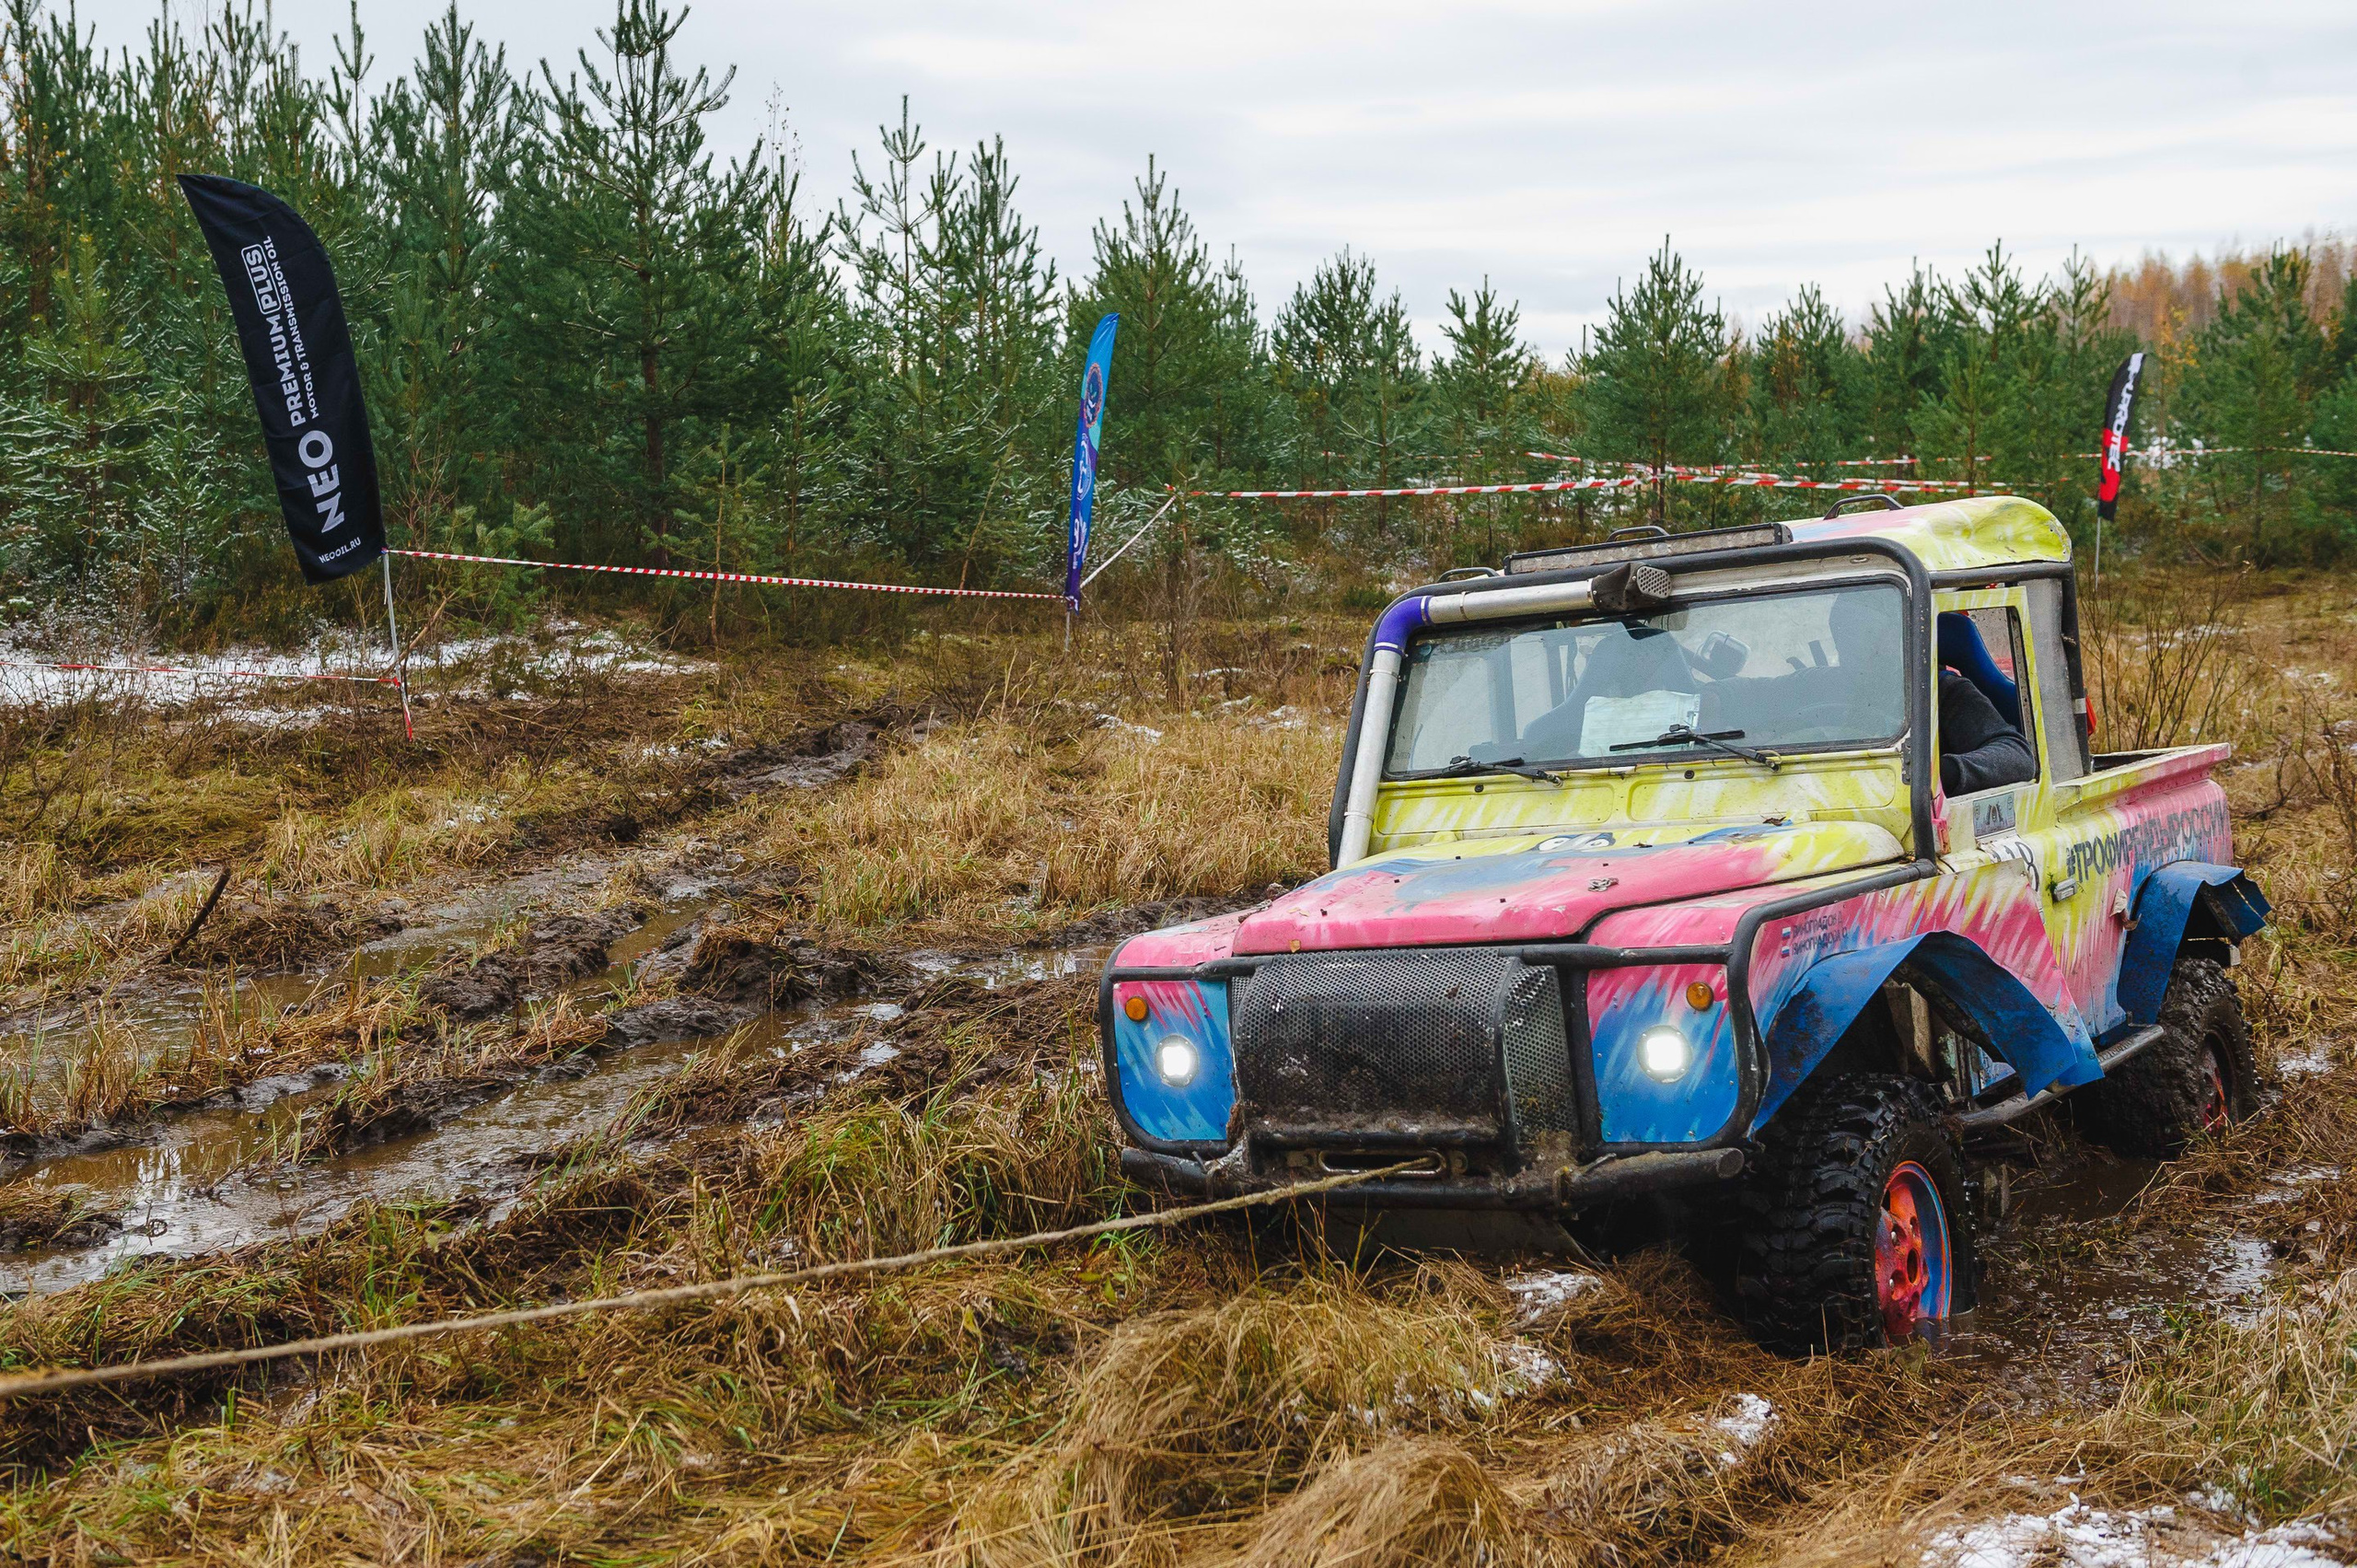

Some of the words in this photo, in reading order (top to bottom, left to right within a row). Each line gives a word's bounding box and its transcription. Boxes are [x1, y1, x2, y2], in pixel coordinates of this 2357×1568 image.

[263, 236, 276, 260] OIL
[246, 249, 278, 310] PLUS
[271, 261, 307, 361] TRANSMISSION
[266, 314, 306, 427] PREMIUM
[300, 362, 309, 371] &
[303, 372, 319, 419] MOTOR
[298, 430, 344, 533] NEO
[319, 537, 361, 563] NEOOIL.RU
